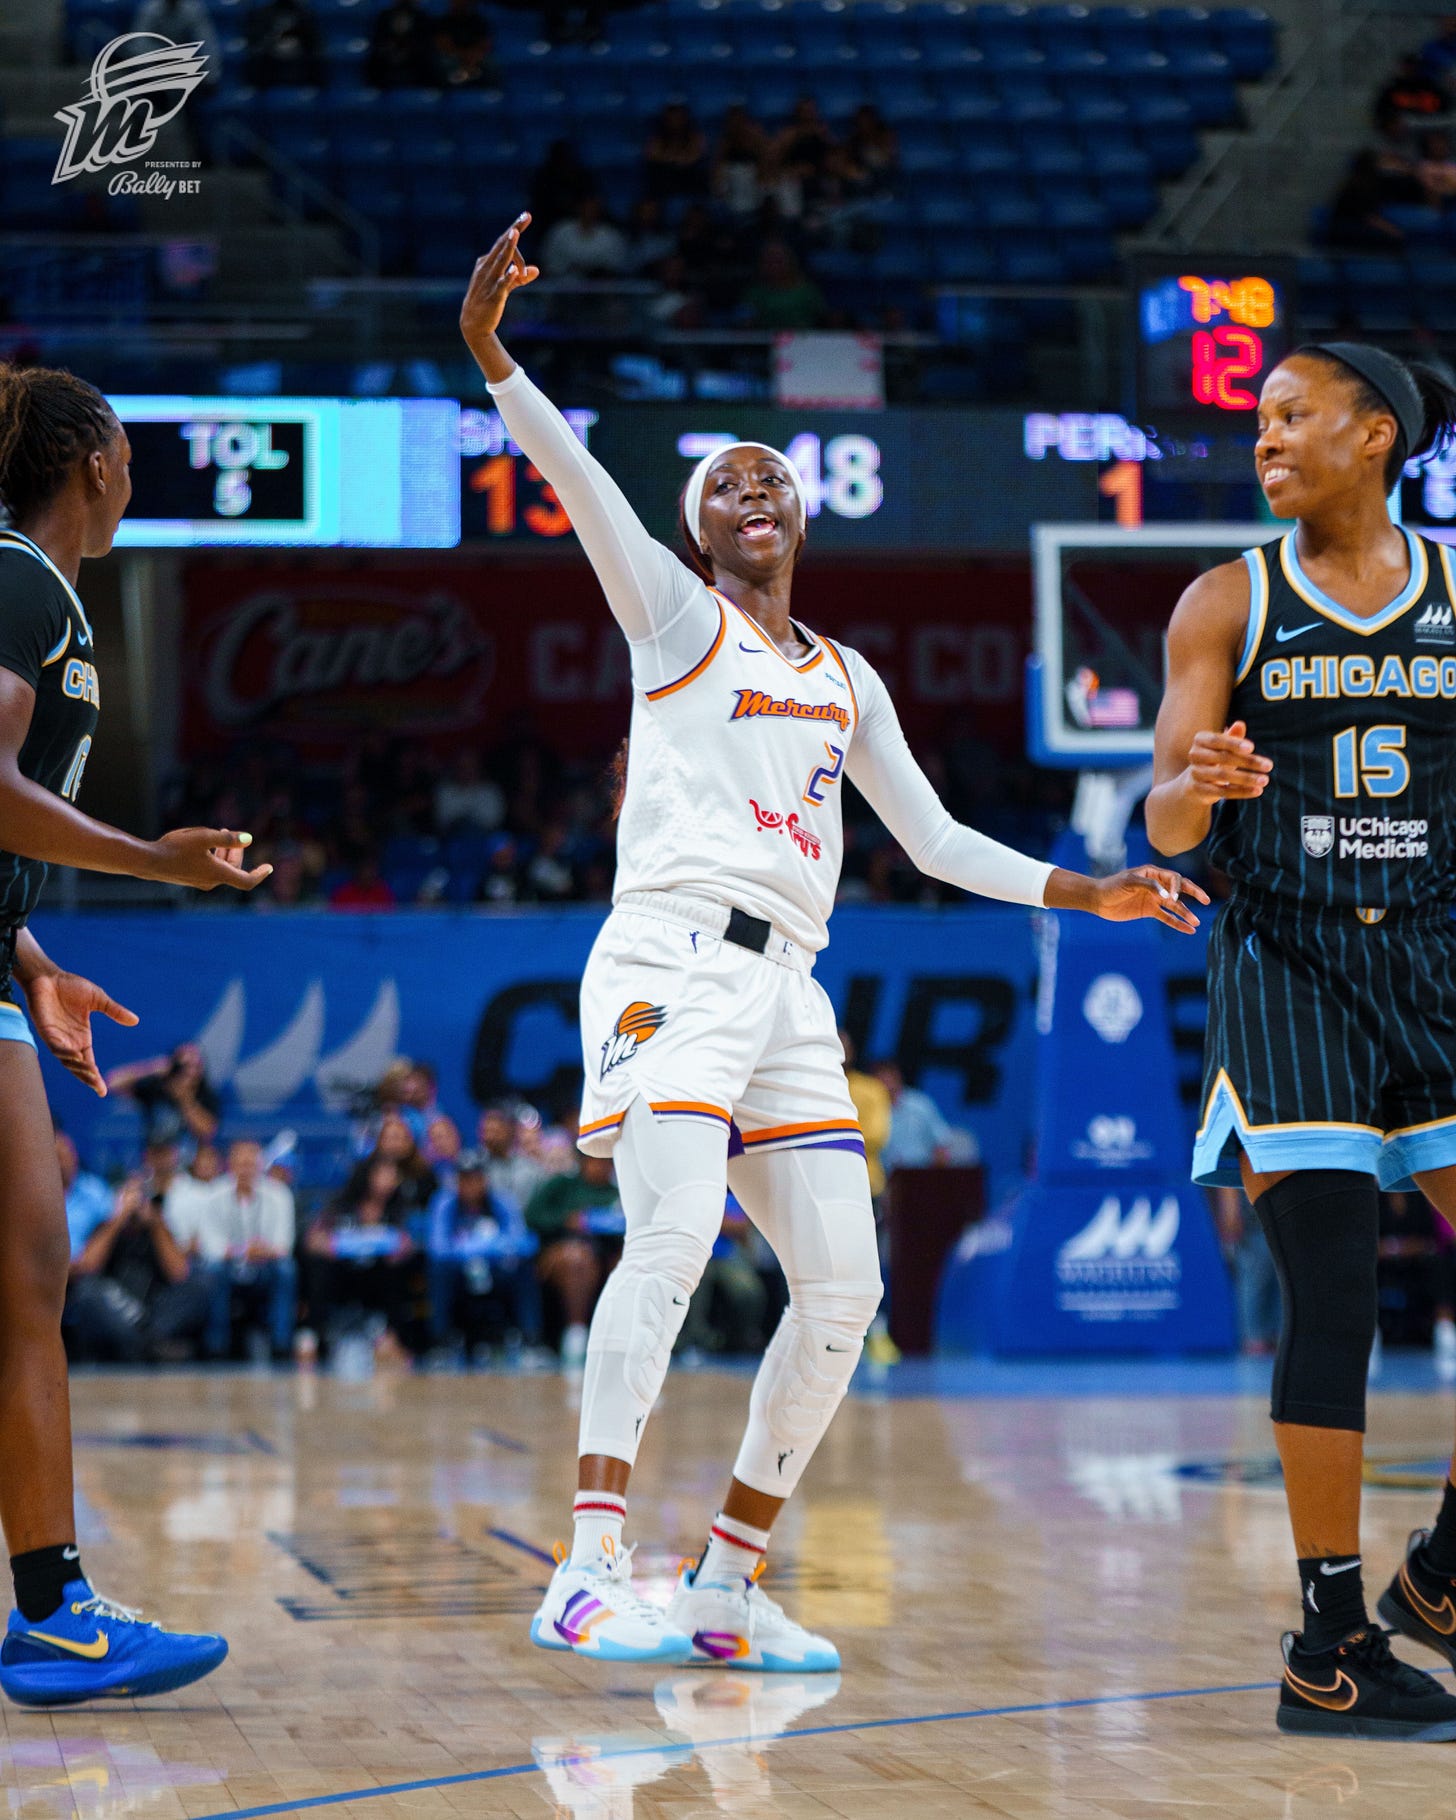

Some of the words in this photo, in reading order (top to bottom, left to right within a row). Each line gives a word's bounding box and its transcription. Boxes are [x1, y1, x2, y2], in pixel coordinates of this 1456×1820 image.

[1192, 326, 1263, 410] 12
[181, 421, 290, 470] TOL
[728, 688, 850, 734] Mercury
[802, 740, 845, 808] 2
[1332, 724, 1411, 798] 15
[1339, 817, 1428, 838] UChicago
[1339, 838, 1429, 859] Medicine
